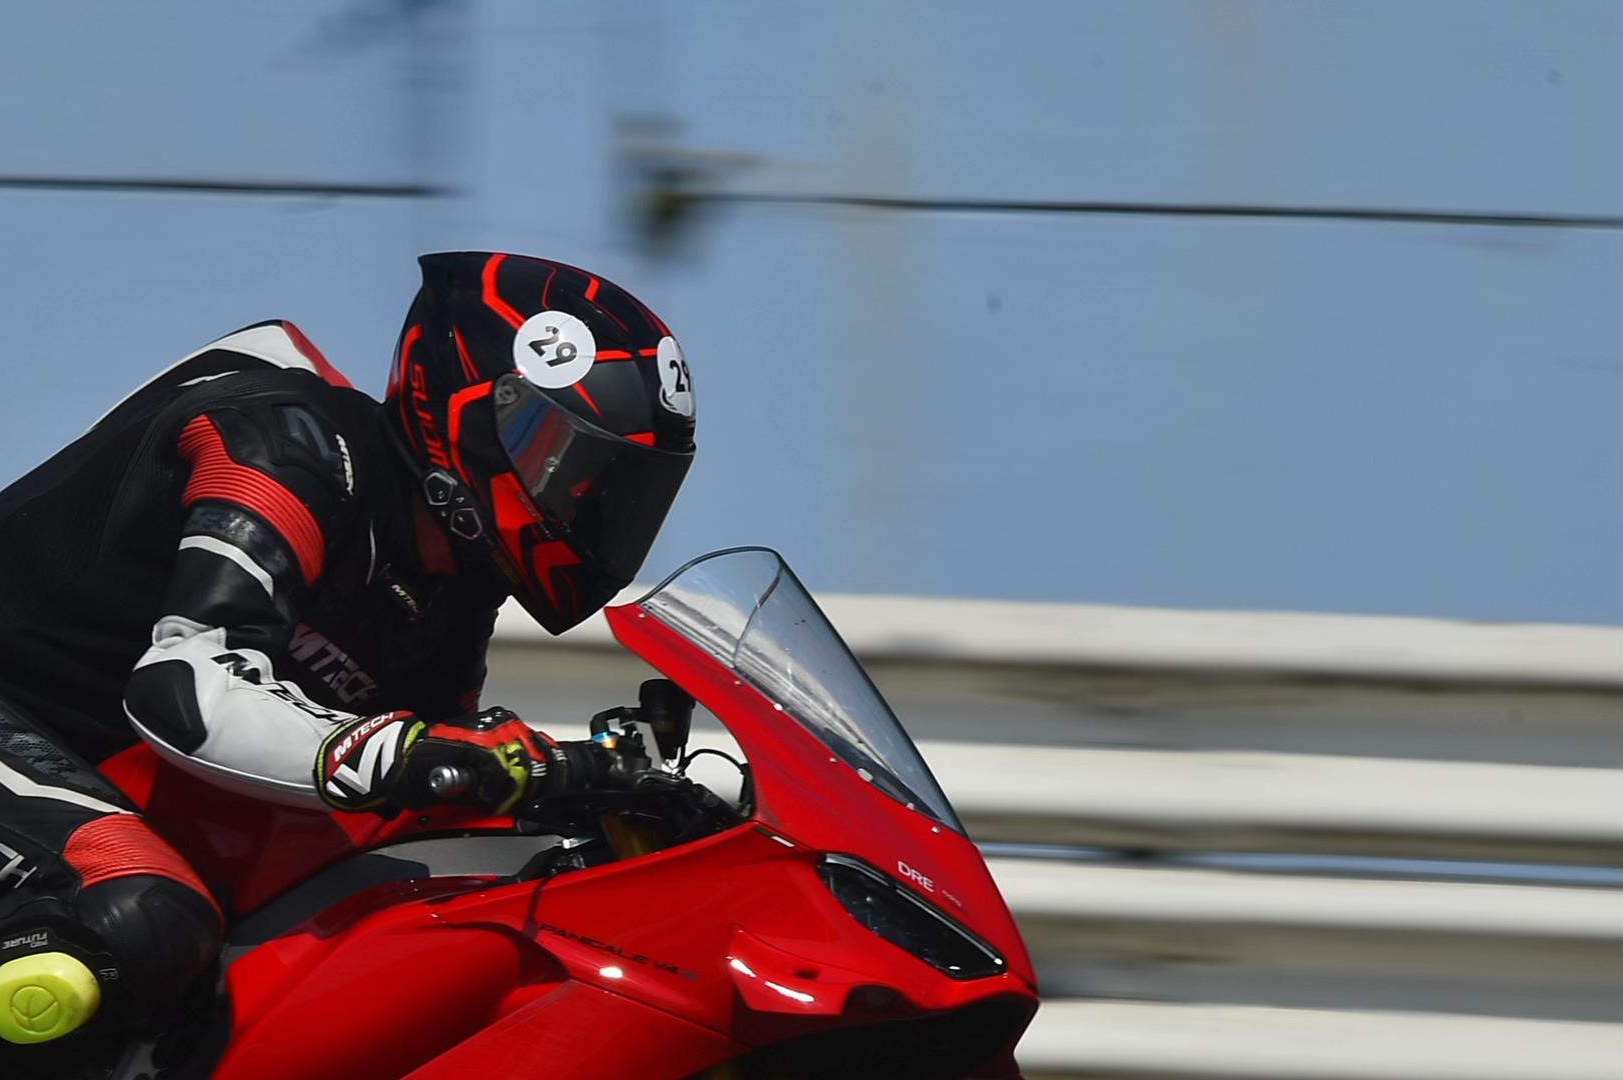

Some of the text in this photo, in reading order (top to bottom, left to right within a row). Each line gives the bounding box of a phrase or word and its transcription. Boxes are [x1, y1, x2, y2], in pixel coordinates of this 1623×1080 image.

[528, 325, 577, 367] 29
[669, 359, 691, 392] 29
[409, 363, 451, 469] SUOM
[391, 583, 424, 616] MTE
[333, 712, 395, 763] MTECH
[896, 861, 934, 893] DRE
[1, 931, 48, 950] FUTURE
